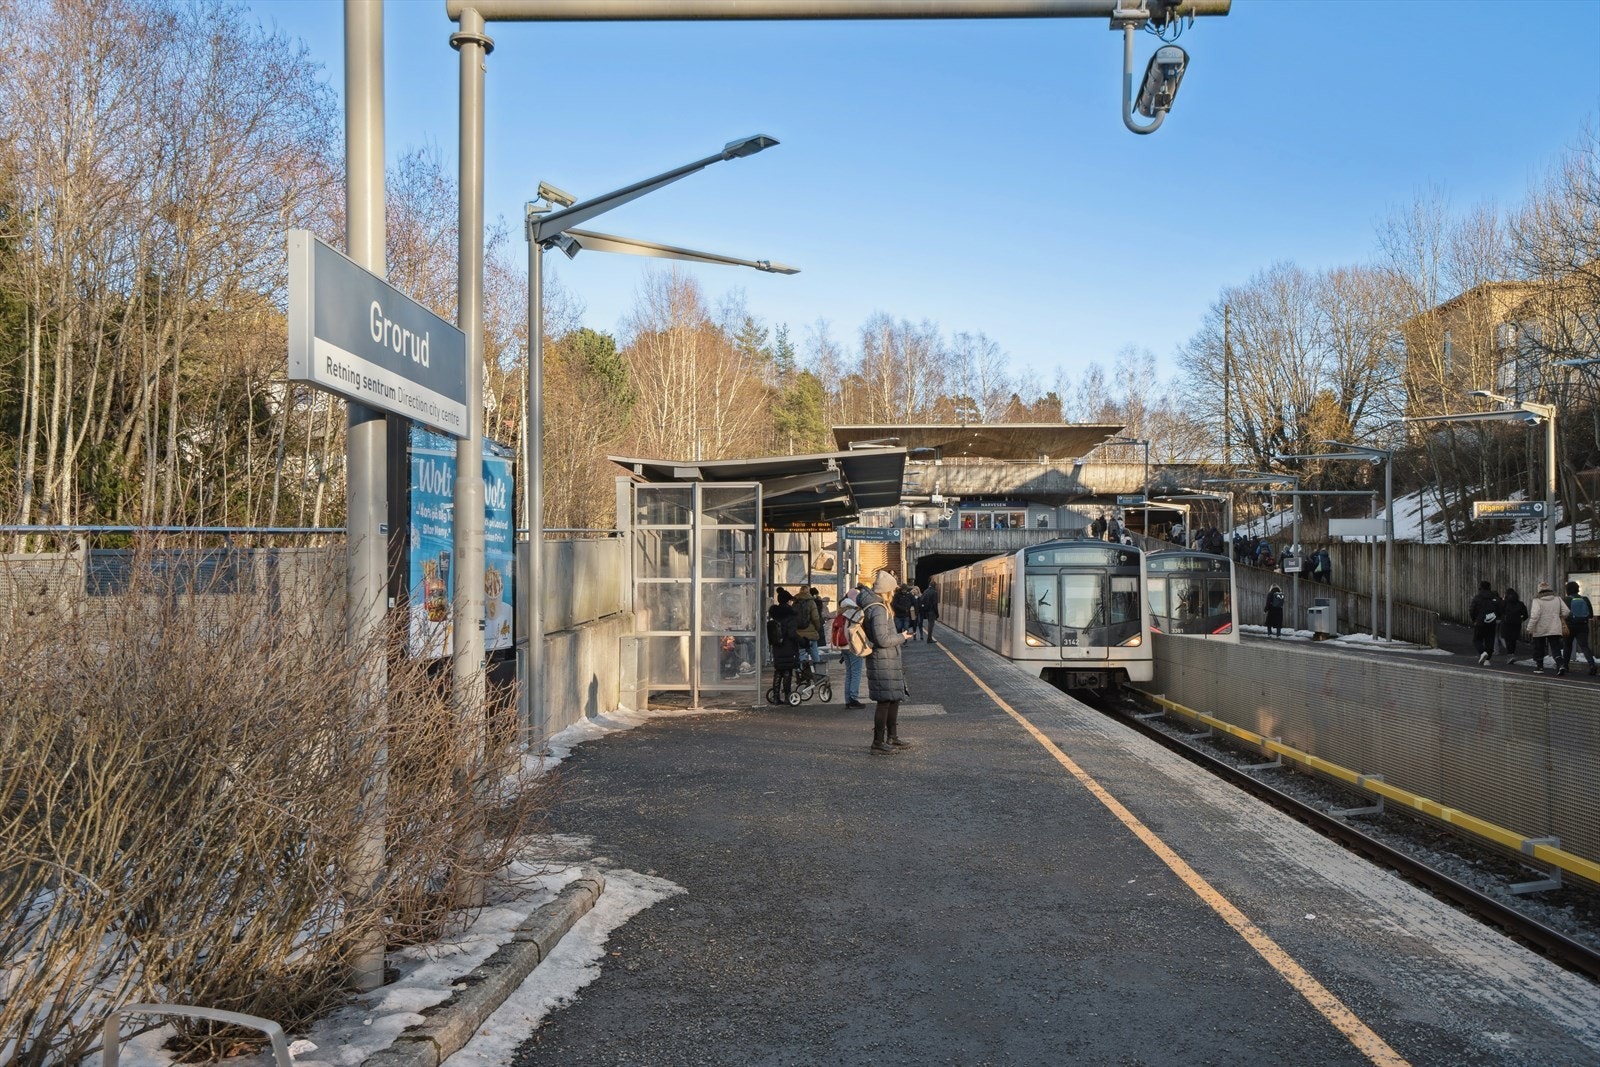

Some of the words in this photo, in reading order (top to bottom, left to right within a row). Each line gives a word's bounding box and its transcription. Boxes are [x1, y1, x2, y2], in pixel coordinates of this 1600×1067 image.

[370, 300, 430, 368] Grorud
[326, 355, 361, 390] Retning
[362, 376, 396, 401] sentrum
[398, 386, 428, 413] Direction
[429, 401, 441, 422] city
[441, 410, 460, 426] centre
[420, 459, 452, 497] Wolt
[1479, 503, 1505, 512] Utgang
[847, 528, 866, 536] Utgang
[1063, 638, 1080, 646] 3142
